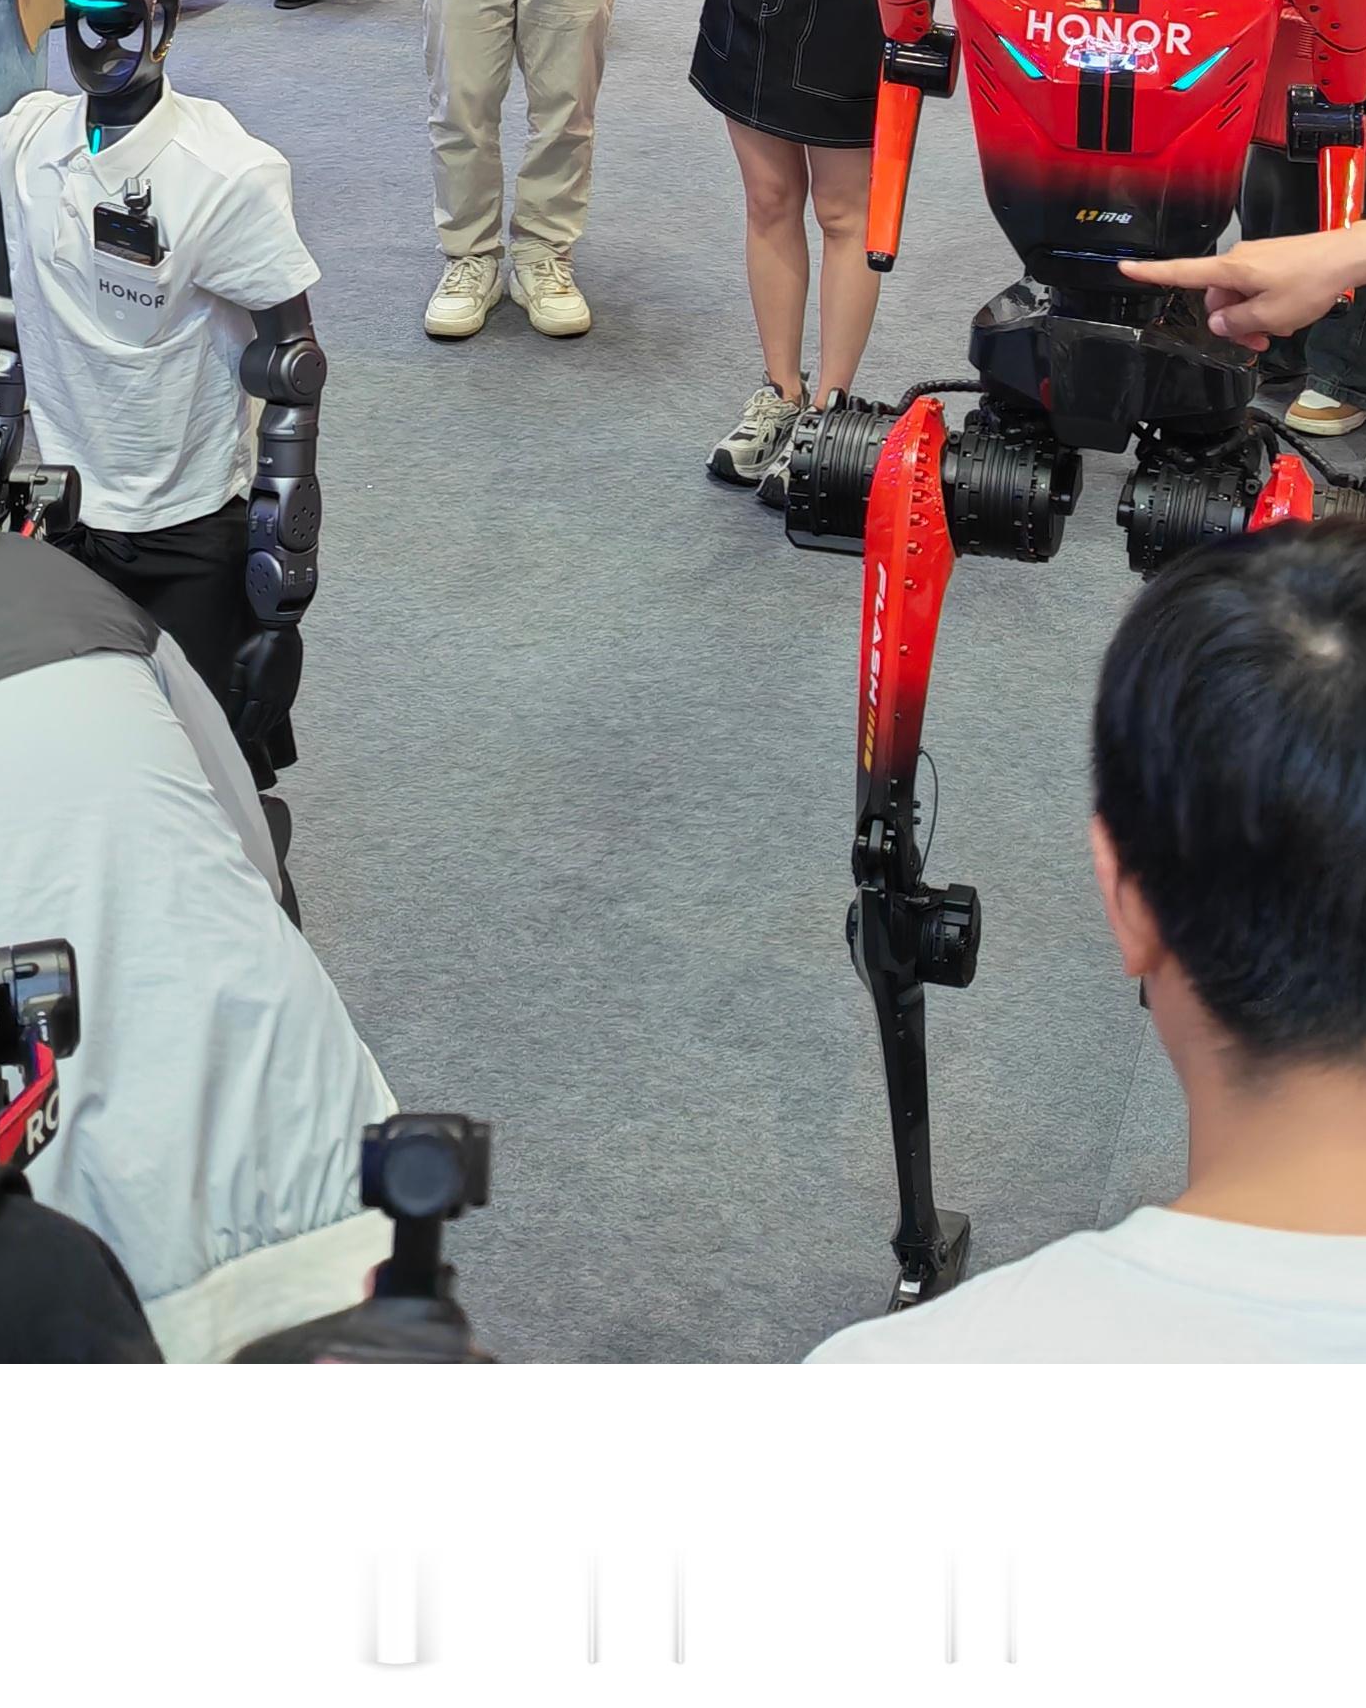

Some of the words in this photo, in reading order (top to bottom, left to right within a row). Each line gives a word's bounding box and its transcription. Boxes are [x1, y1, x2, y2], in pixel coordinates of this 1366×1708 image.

[1026, 9, 1192, 56] HONOR
[99, 278, 166, 309] HONOR
[869, 561, 887, 707] FLASH
